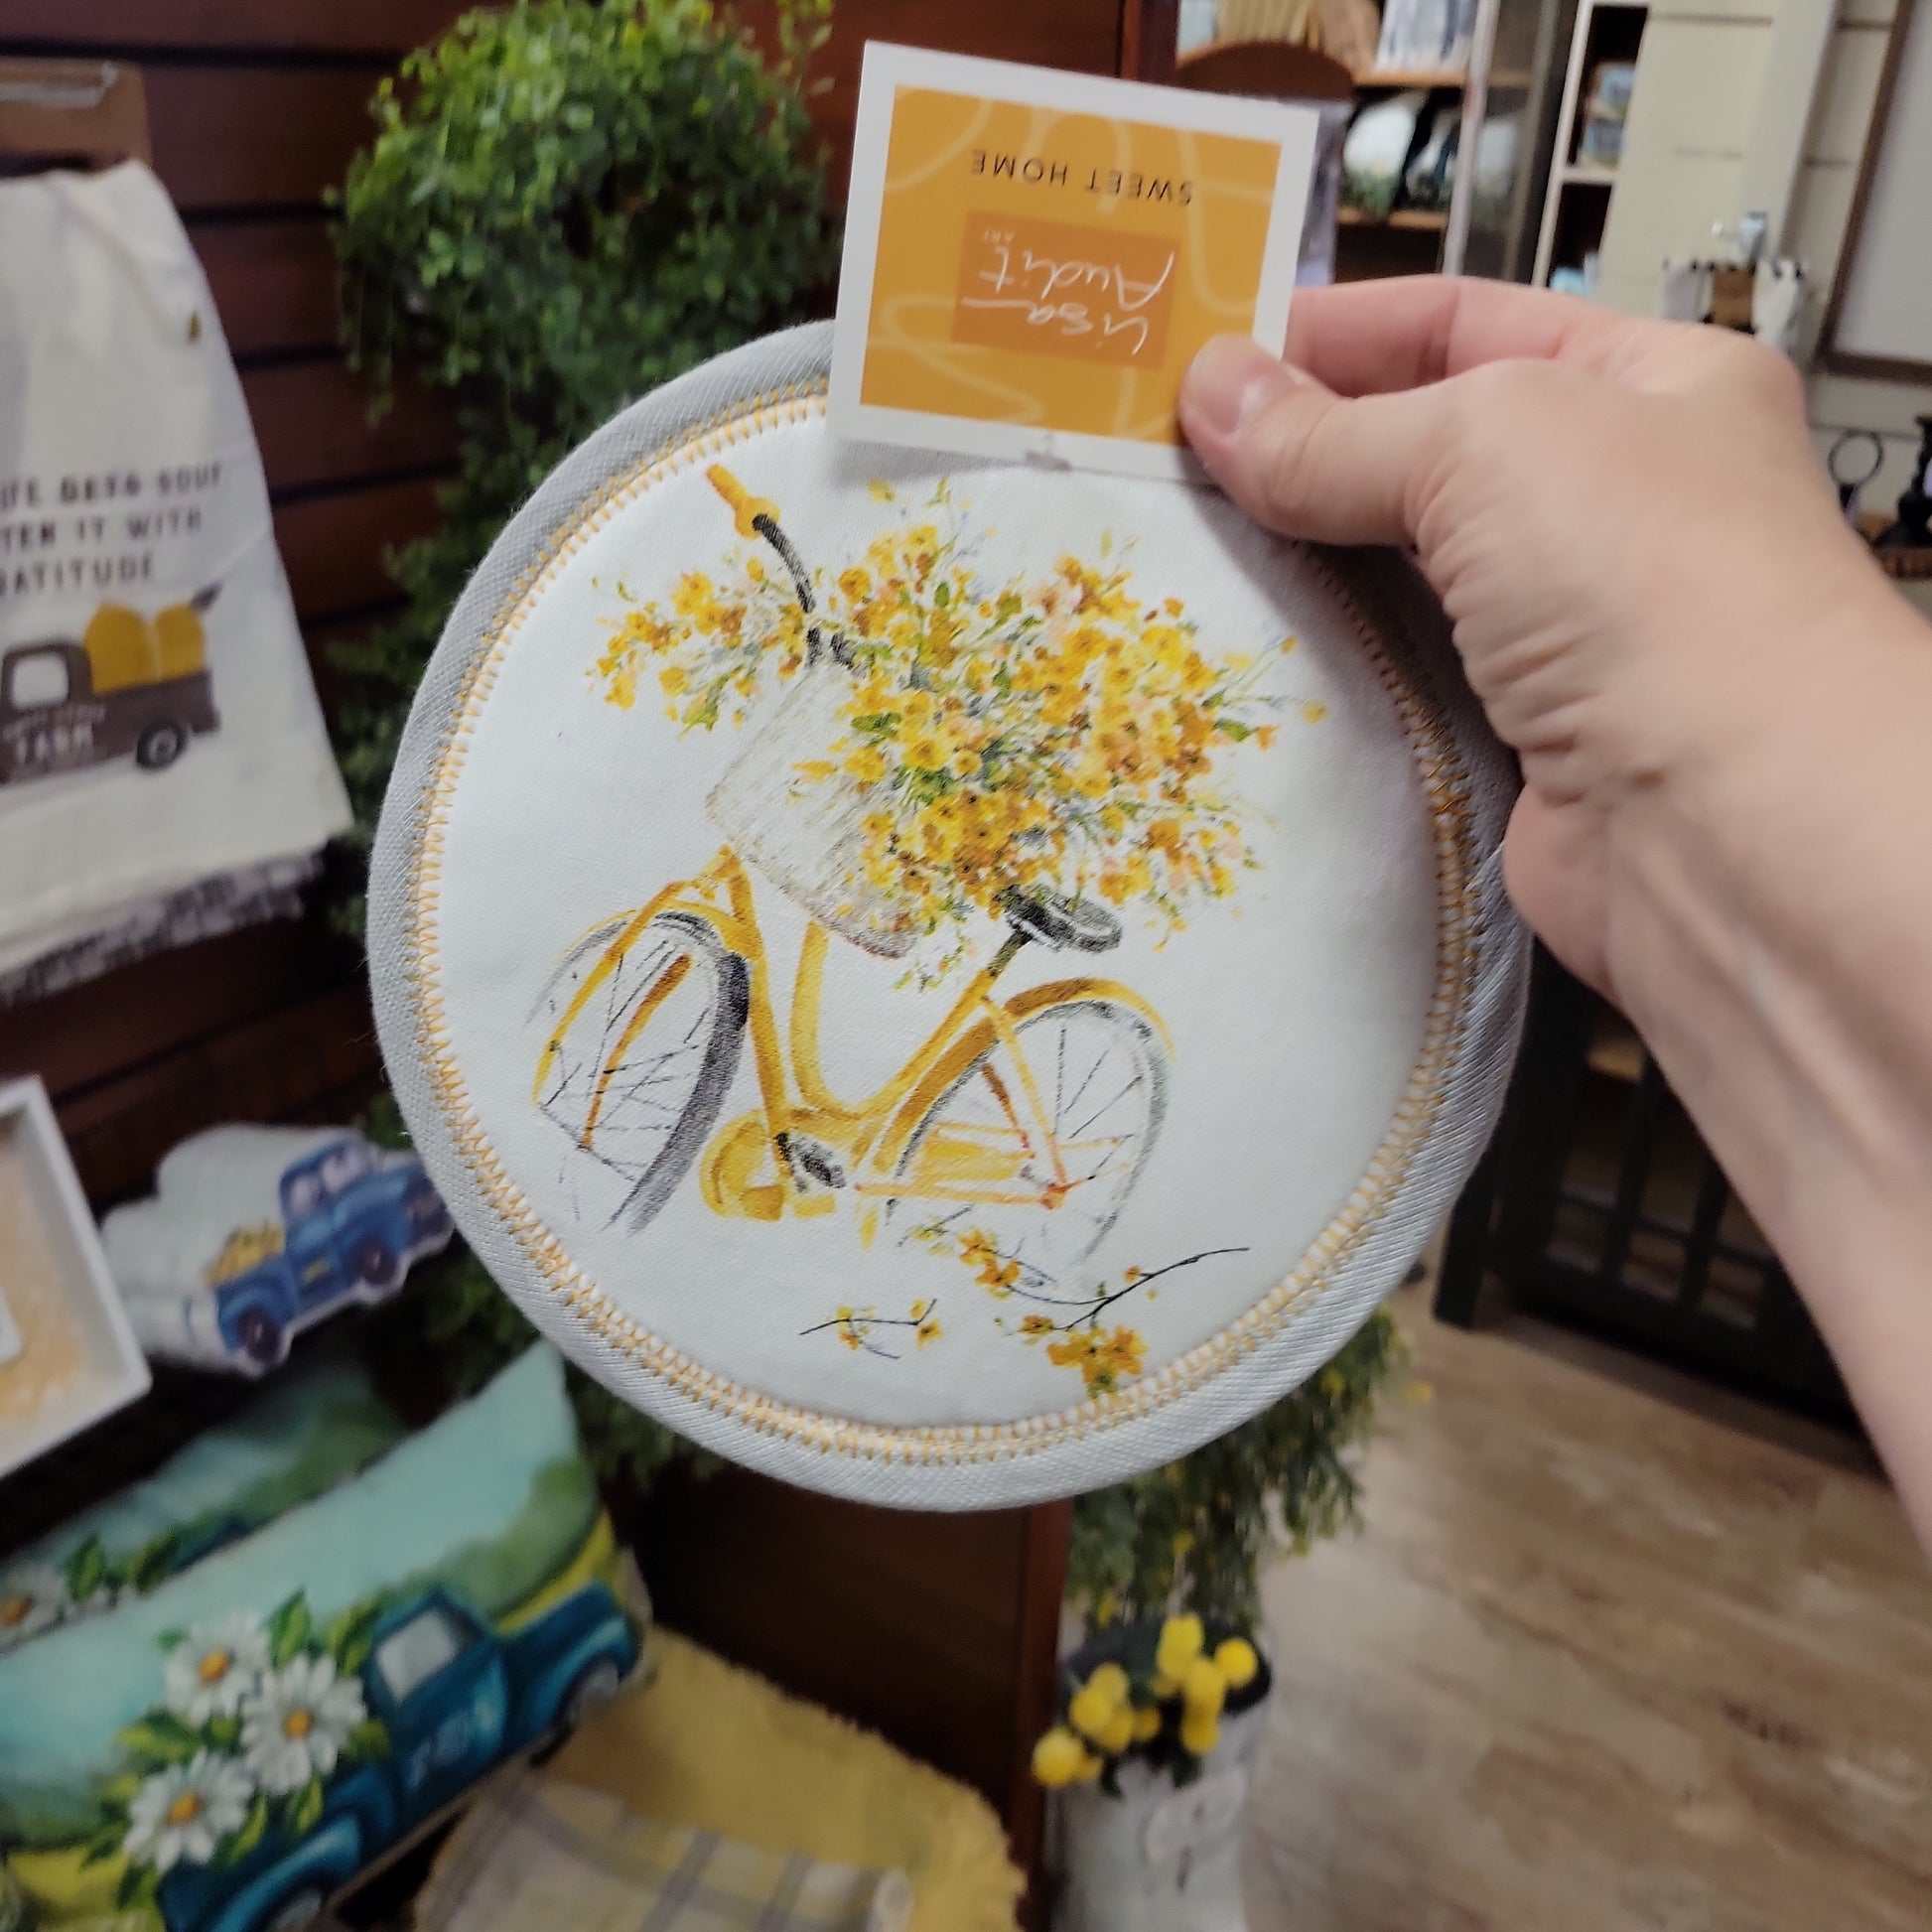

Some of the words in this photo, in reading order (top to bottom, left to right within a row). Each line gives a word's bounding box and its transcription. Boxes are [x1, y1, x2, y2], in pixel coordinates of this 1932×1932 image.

[971, 149, 1069, 187] HOME
[1084, 168, 1193, 207] SWEET
[978, 246, 1175, 312] Audit
[961, 297, 1150, 356] Lisa
[77, 513, 104, 541] IT
[127, 506, 202, 539] WITH
